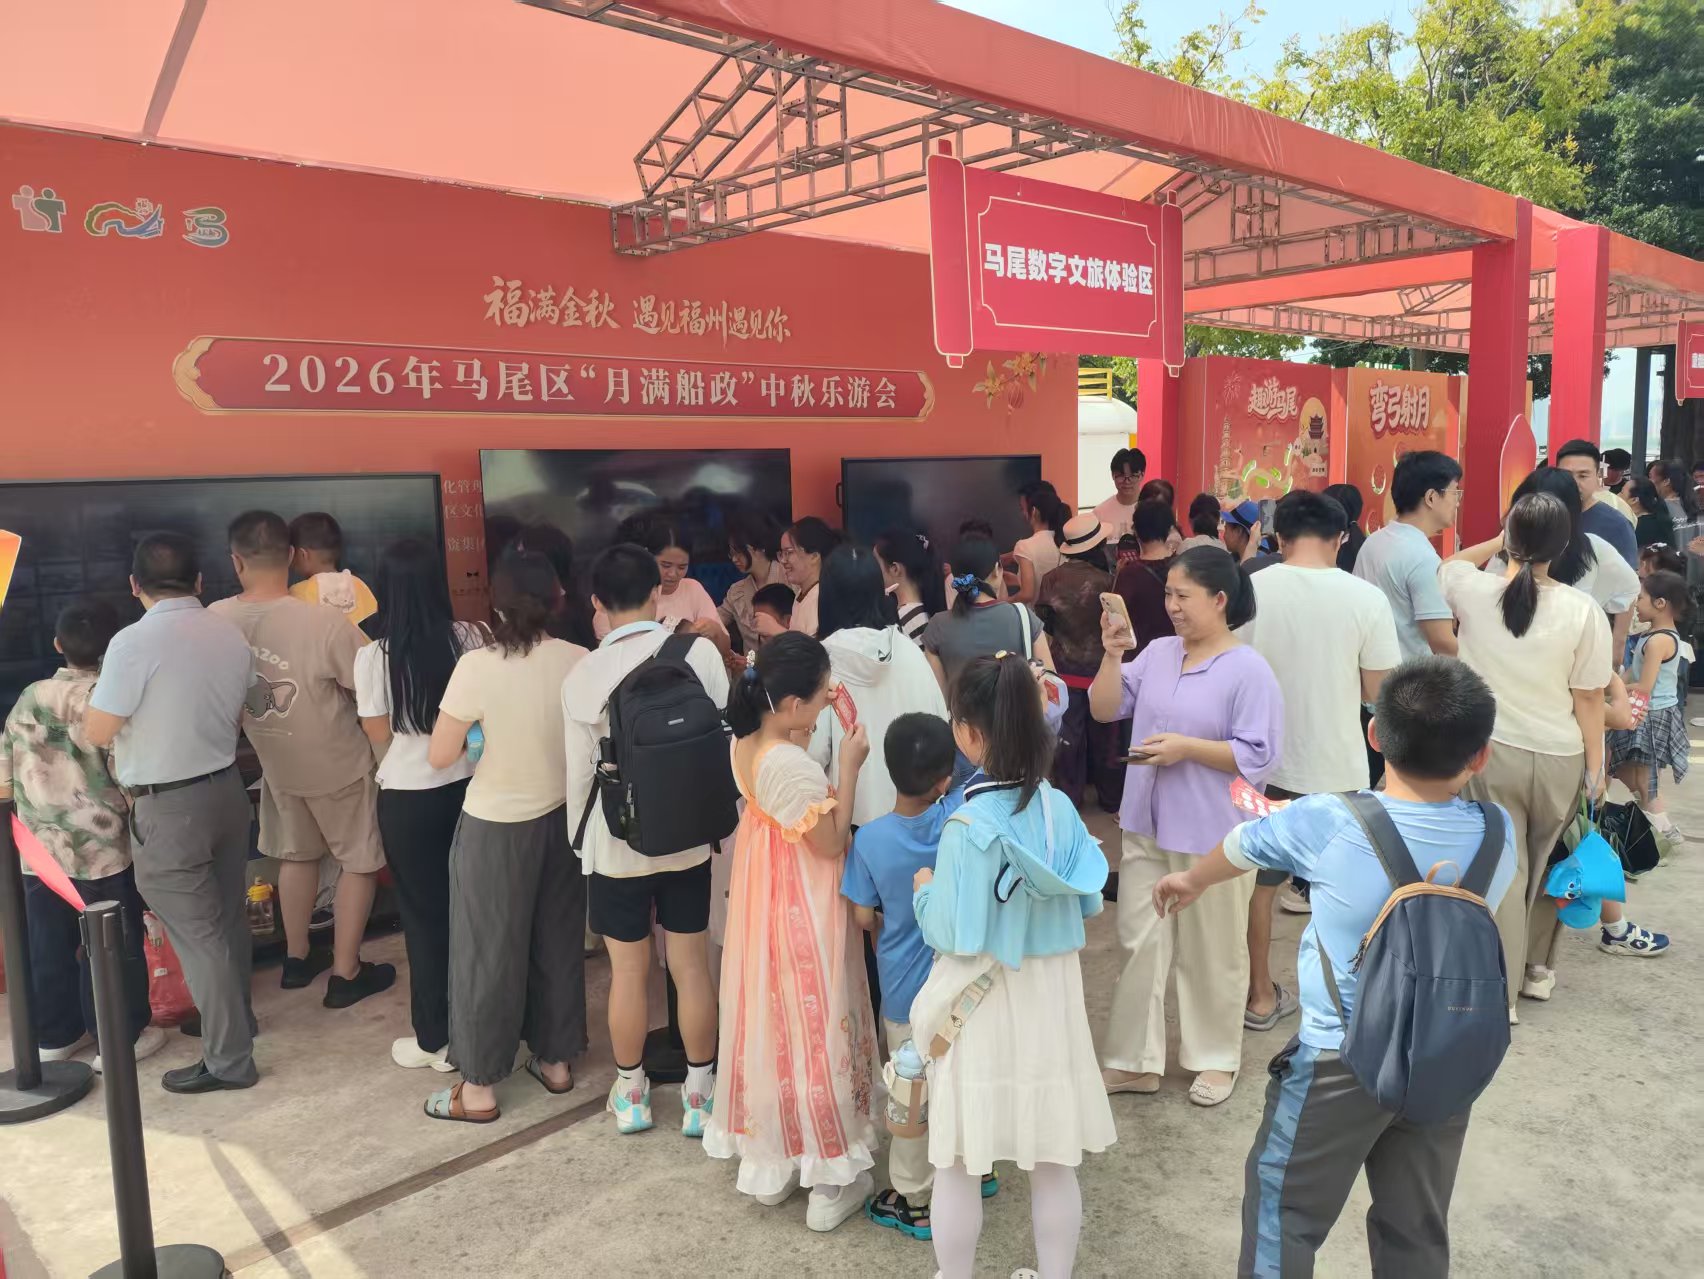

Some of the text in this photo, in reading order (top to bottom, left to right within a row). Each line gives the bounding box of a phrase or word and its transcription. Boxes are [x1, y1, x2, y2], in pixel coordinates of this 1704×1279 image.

[984, 242, 1154, 296] 马尾数字文旅体验区
[482, 275, 791, 352] 福满金秋 遇见福州遇见你
[1369, 379, 1430, 433] 弯弓射月
